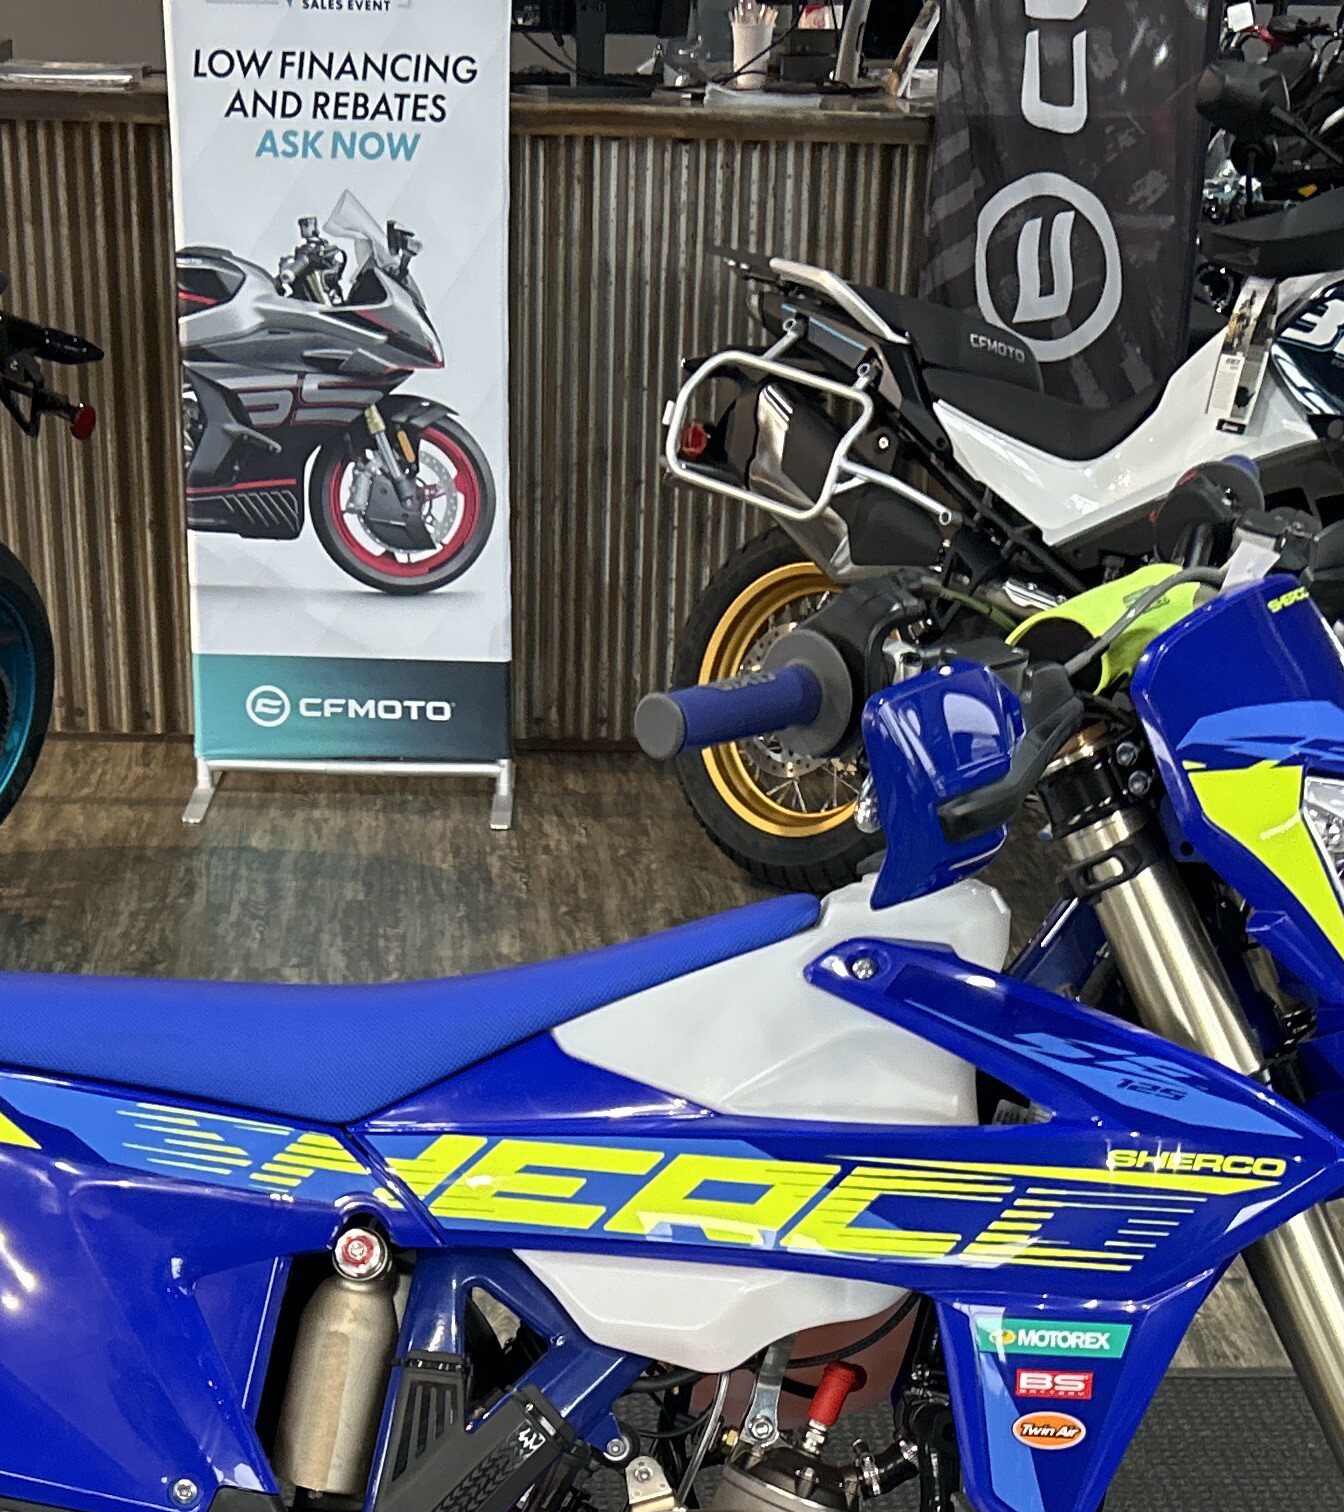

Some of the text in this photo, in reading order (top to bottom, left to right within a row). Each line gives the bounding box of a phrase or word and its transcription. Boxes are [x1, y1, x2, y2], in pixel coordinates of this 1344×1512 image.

[301, 0, 391, 12] SALES EVENT
[193, 48, 479, 85] LOW FINANCING
[223, 89, 447, 123] AND REBATES
[255, 129, 422, 162] ASK NOW
[968, 332, 1026, 364] CFMOTO
[298, 696, 453, 723] CFMOTO
[1115, 1077, 1190, 1102] 125
[1107, 1148, 1288, 1178] SHERCO
[1017, 1328, 1112, 1351] MOTOREX
[1019, 1372, 1086, 1392] BS
[1020, 1422, 1081, 1438] Twin Air
